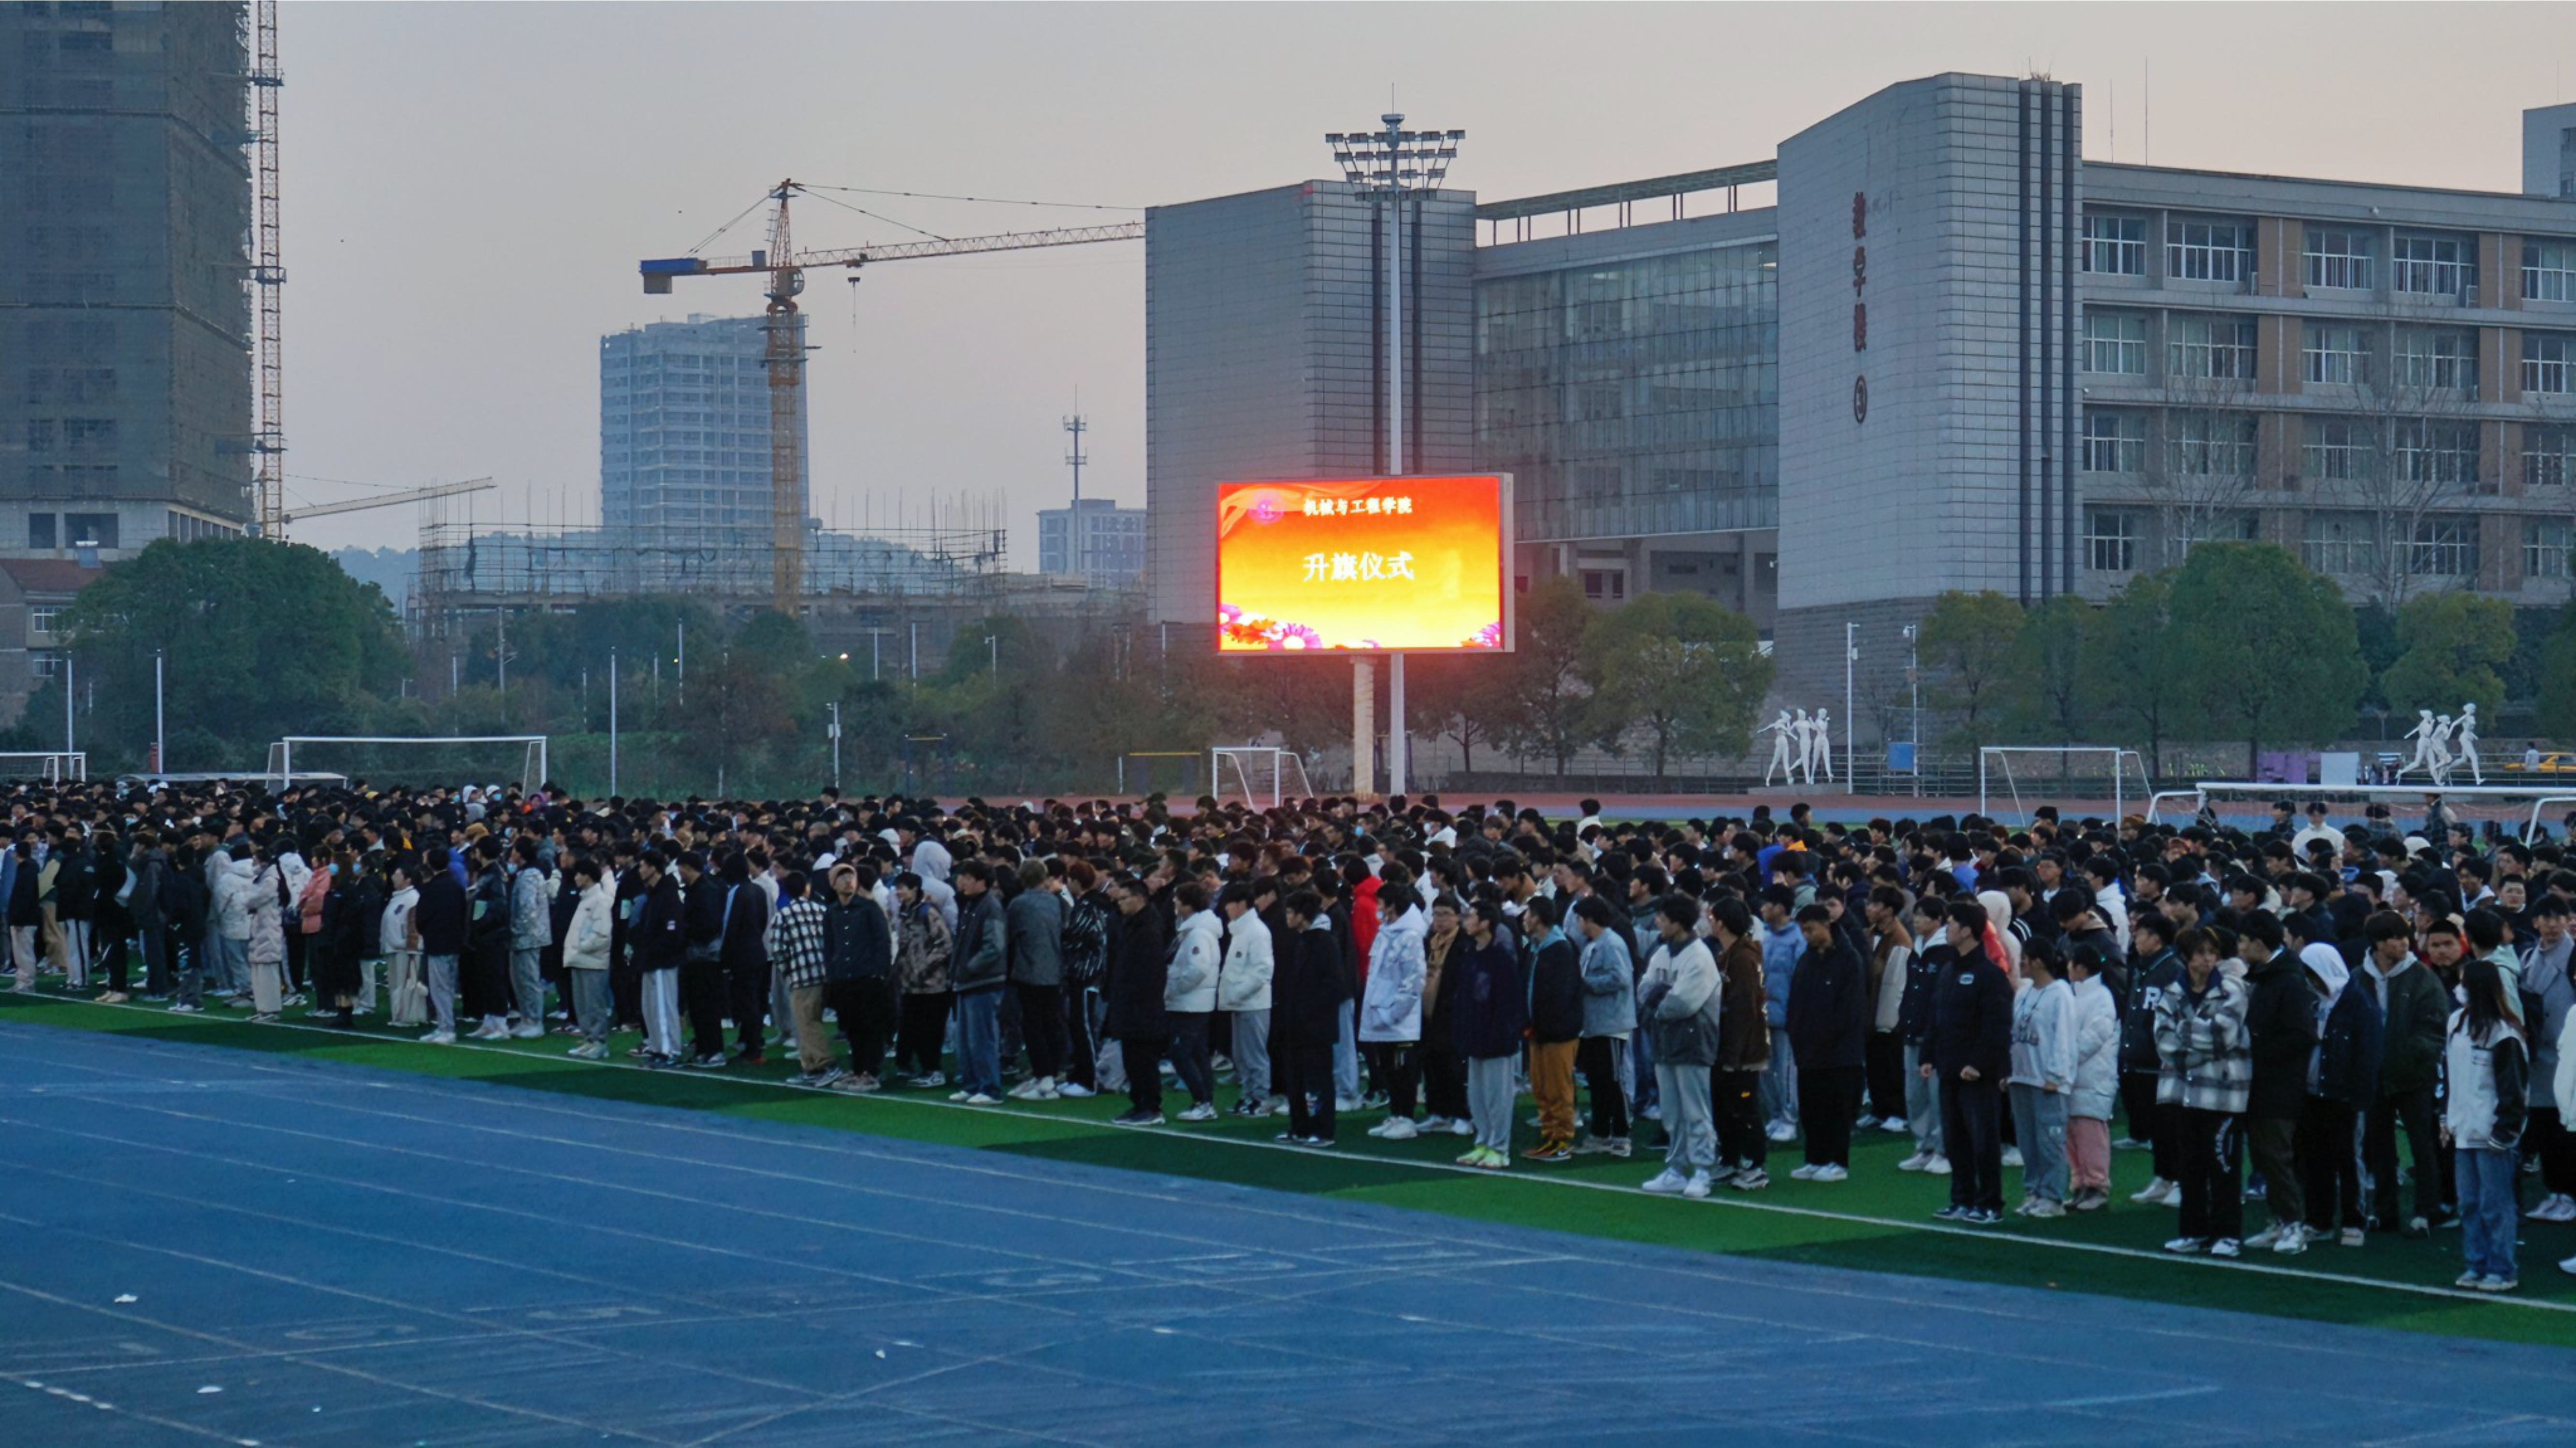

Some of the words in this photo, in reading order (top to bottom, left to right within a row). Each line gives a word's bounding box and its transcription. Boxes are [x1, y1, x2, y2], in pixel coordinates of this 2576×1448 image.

[1303, 496, 1412, 516] 机械与工程学院
[1303, 550, 1414, 581] 升旗仪式
[2142, 986, 2161, 1010] R
